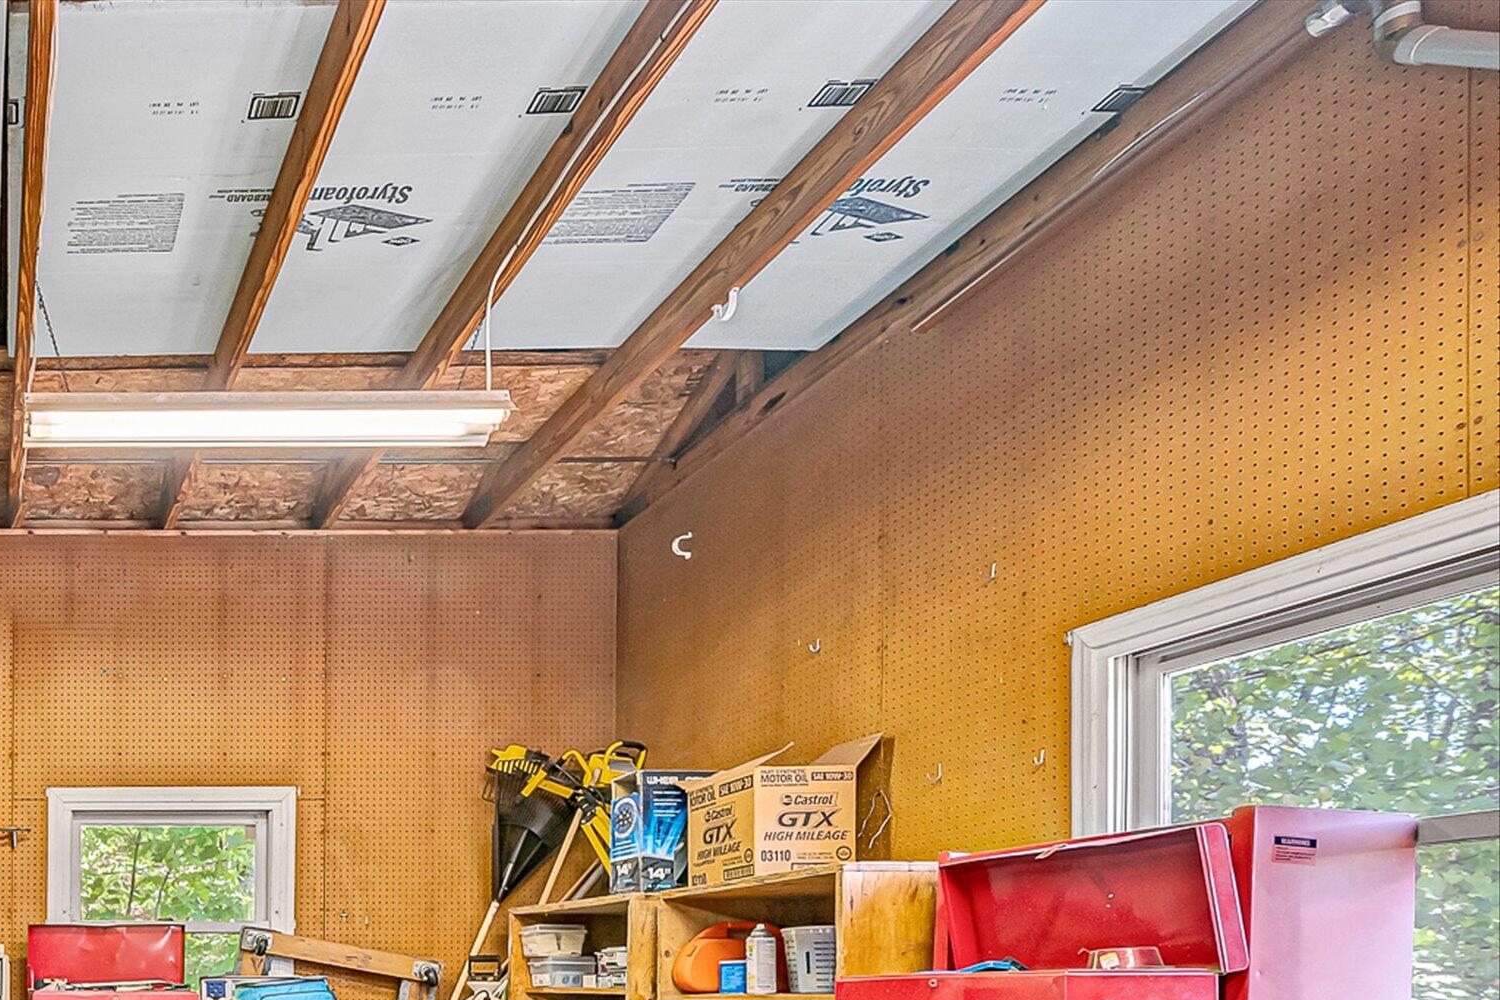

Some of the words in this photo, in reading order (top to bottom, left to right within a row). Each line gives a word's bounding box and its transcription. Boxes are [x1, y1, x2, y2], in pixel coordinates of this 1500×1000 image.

[848, 176, 931, 198] Styrofo
[761, 774, 793, 783] MOTOR
[795, 774, 808, 783] OIL
[794, 794, 833, 806] Castrol
[777, 810, 840, 828] GTX
[703, 819, 738, 845] GTX
[763, 832, 793, 841] HIGH
[795, 830, 849, 840] MILEAGE
[761, 850, 791, 862] 03110
